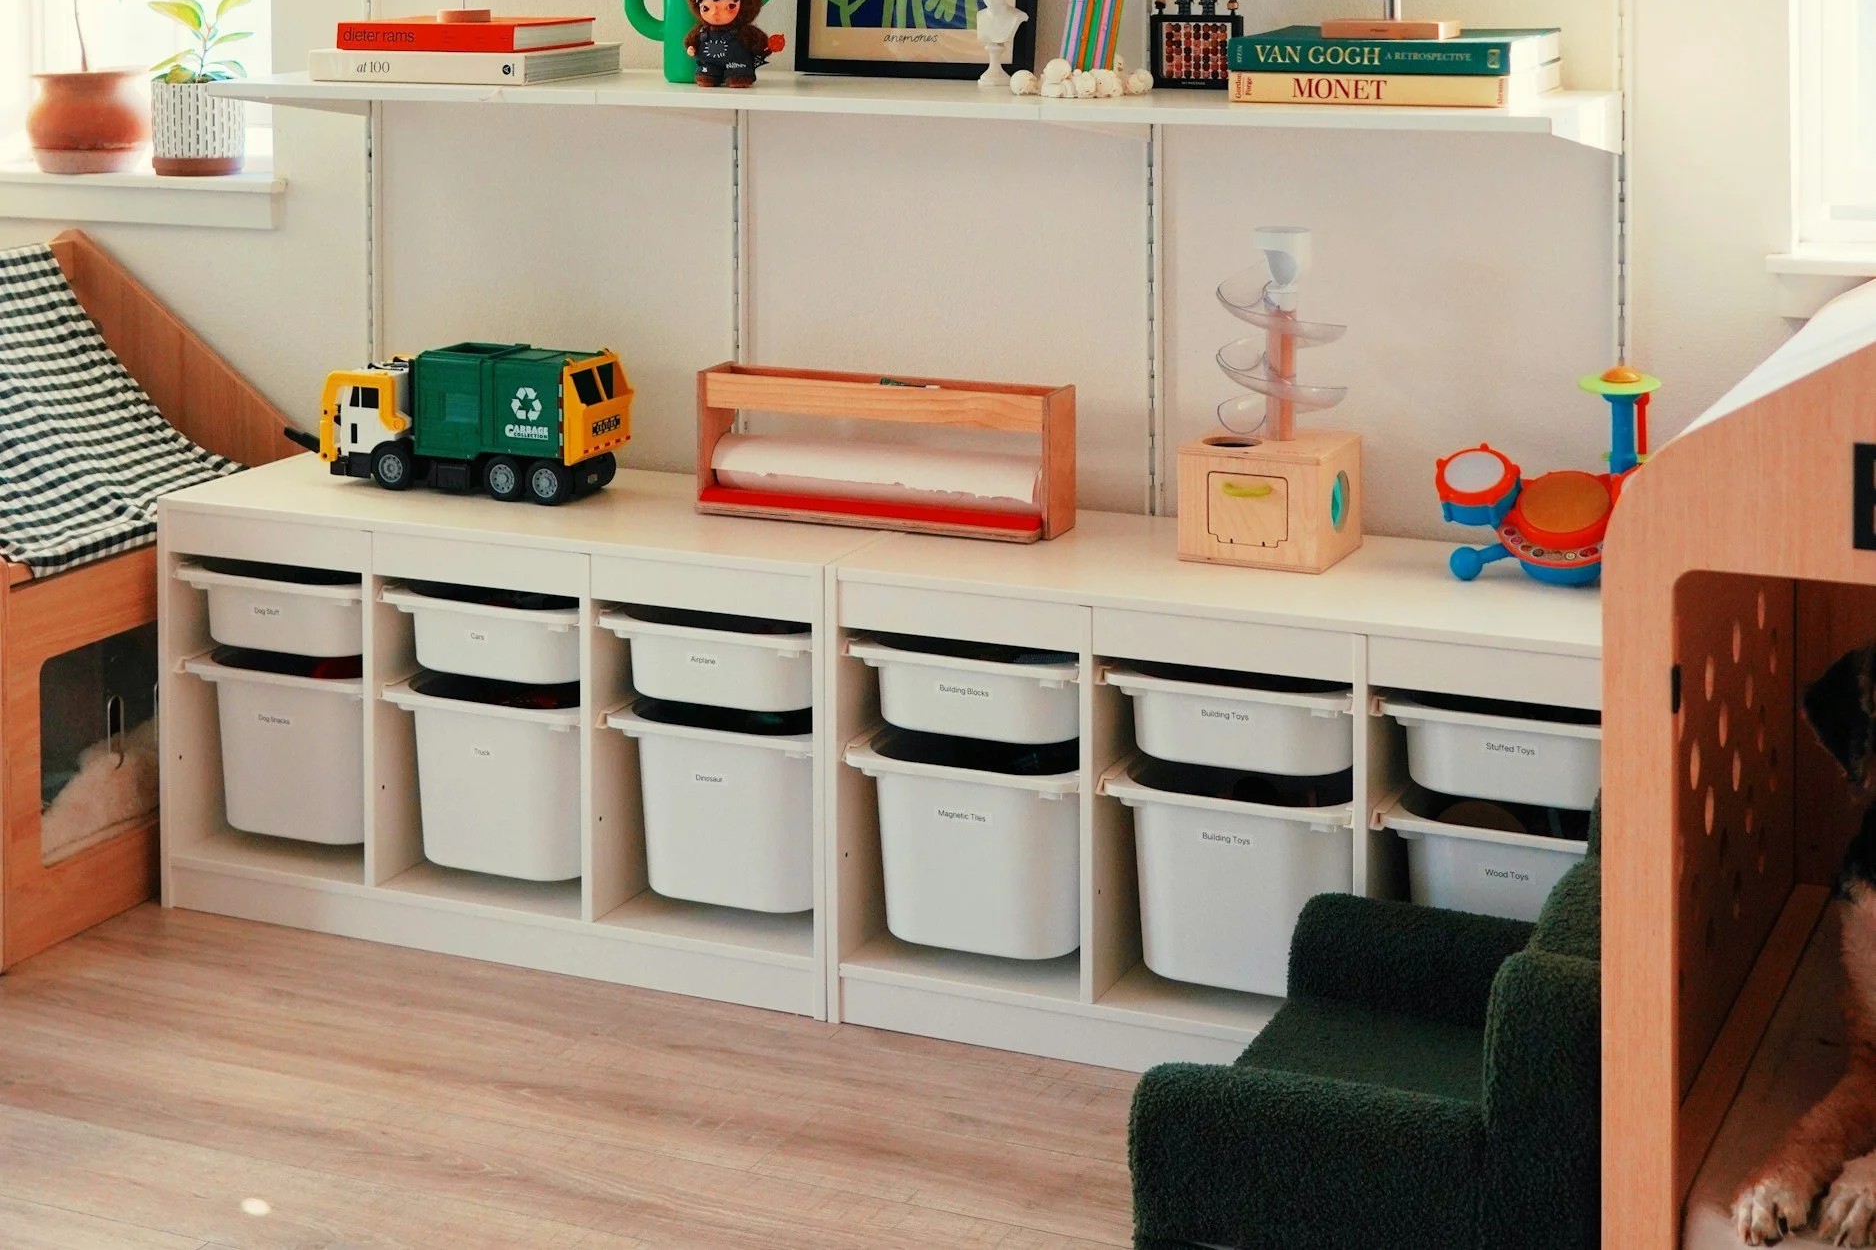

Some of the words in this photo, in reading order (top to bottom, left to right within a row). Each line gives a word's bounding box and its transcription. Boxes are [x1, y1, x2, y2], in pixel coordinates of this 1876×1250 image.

[343, 28, 379, 42] dieter
[382, 30, 415, 43] rams
[884, 34, 938, 43] anemones
[1255, 44, 1301, 64] VAN
[1307, 45, 1381, 65] GOGH
[1384, 51, 1392, 60] A
[1394, 51, 1472, 62] RETROSPECTIVE
[356, 62, 367, 73] at
[369, 60, 390, 73] 100
[1235, 73, 1243, 99] Gordon
[1292, 77, 1387, 100] MONET
[504, 424, 549, 437] GARBAGE
[514, 432, 548, 440] COLLECTION
[254, 607, 266, 616] Dog
[470, 632, 485, 641] Cars
[690, 655, 716, 665] Airplane
[940, 684, 966, 695] Building
[967, 687, 989, 697] Blocks
[258, 714, 270, 723] Dog
[271, 716, 290, 724] Snacks
[1201, 709, 1230, 720] Building
[1231, 711, 1249, 721] Toys
[474, 748, 491, 756] Truck
[1485, 742, 1515, 753] Stuffed
[1516, 745, 1536, 756] Toys
[695, 773, 723, 783] Dinosaur
[938, 809, 969, 819] Magnetic
[970, 813, 986, 822] Tiles
[1202, 831, 1231, 844] Building
[1232, 835, 1250, 846] Toys
[1485, 868, 1509, 879] Wood
[1510, 871, 1529, 881] Toys
